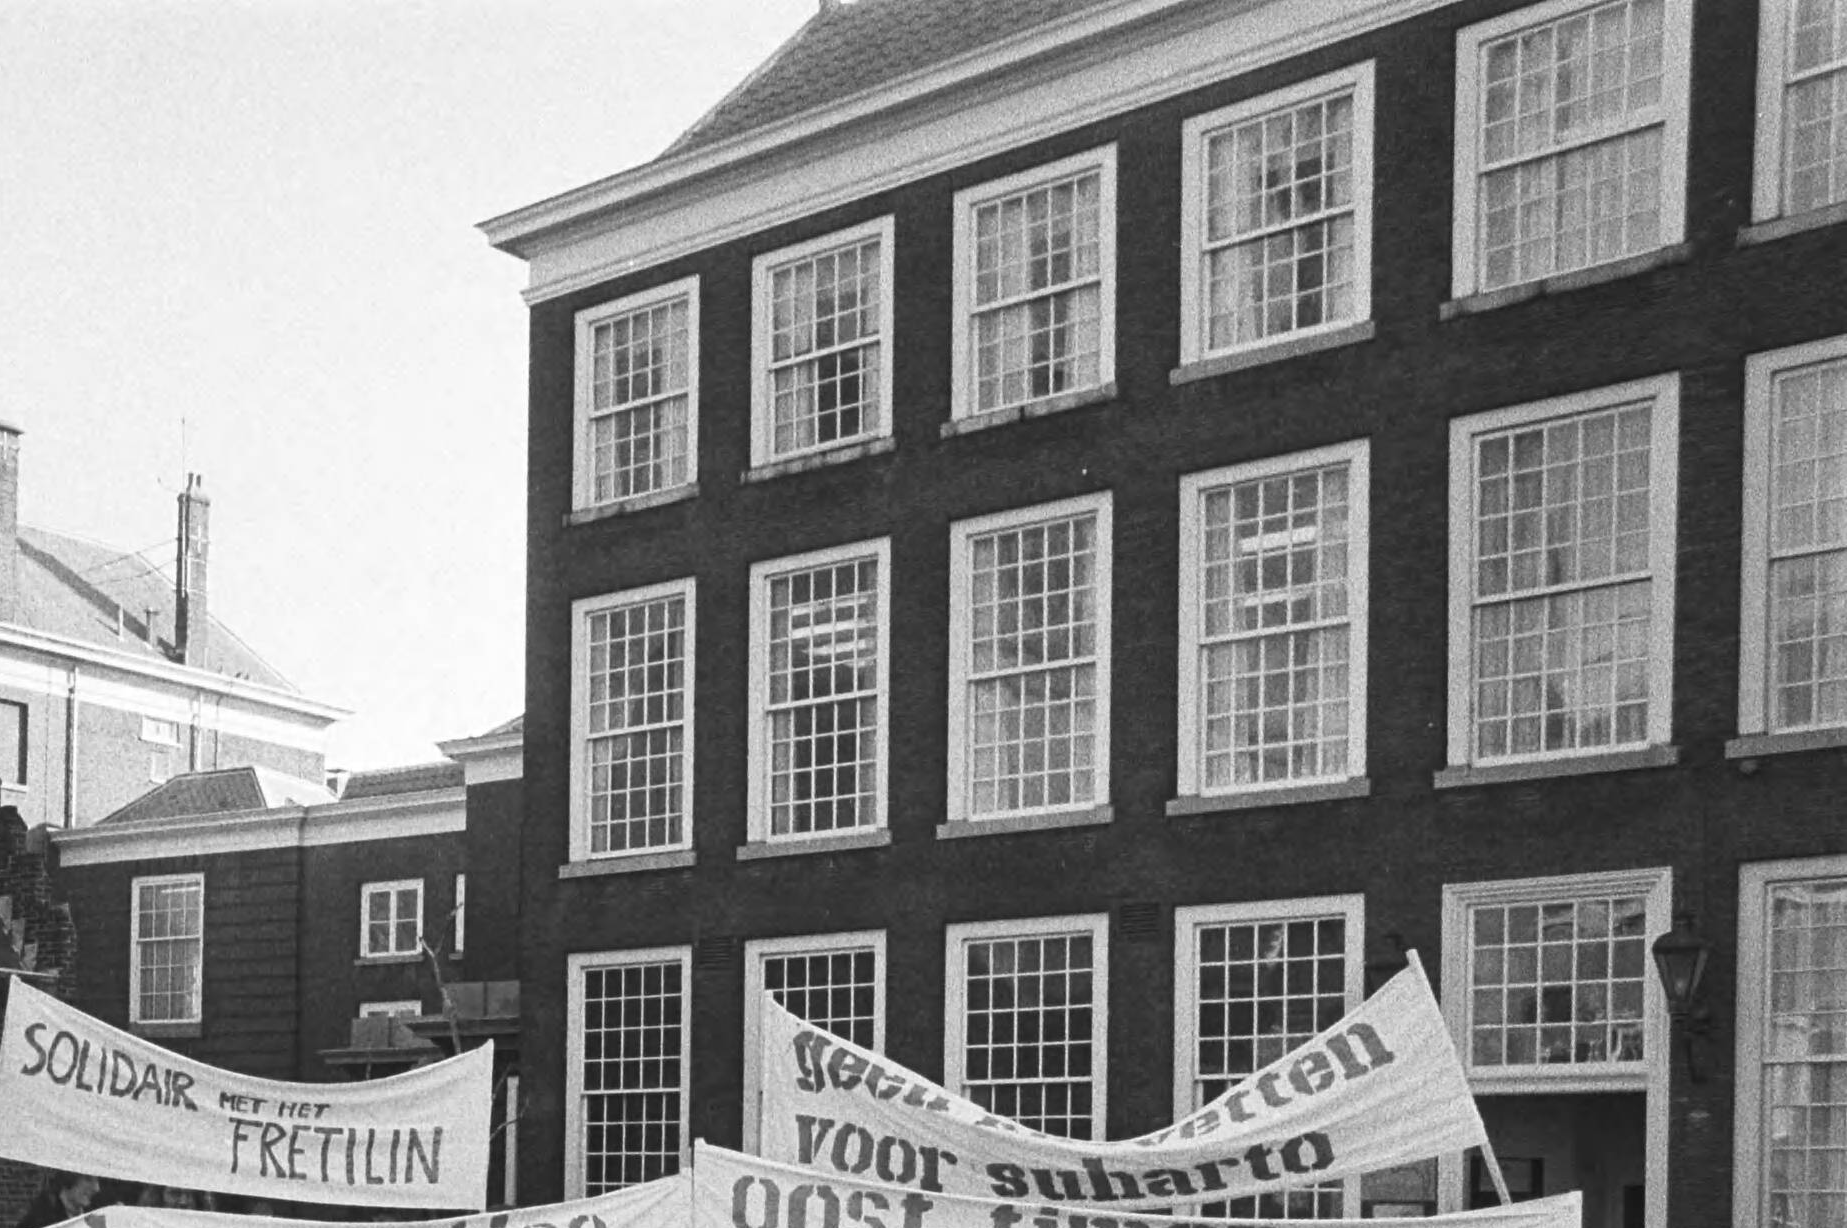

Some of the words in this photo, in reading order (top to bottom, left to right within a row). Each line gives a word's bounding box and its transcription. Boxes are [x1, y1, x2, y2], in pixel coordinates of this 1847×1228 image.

[21, 1022, 198, 1110] SOLIDAIR
[219, 1091, 267, 1117] MET
[277, 1100, 331, 1120] HET
[228, 1116, 444, 1186] FRETILIN
[795, 1114, 959, 1193] voor
[986, 1130, 1335, 1202] suharto
